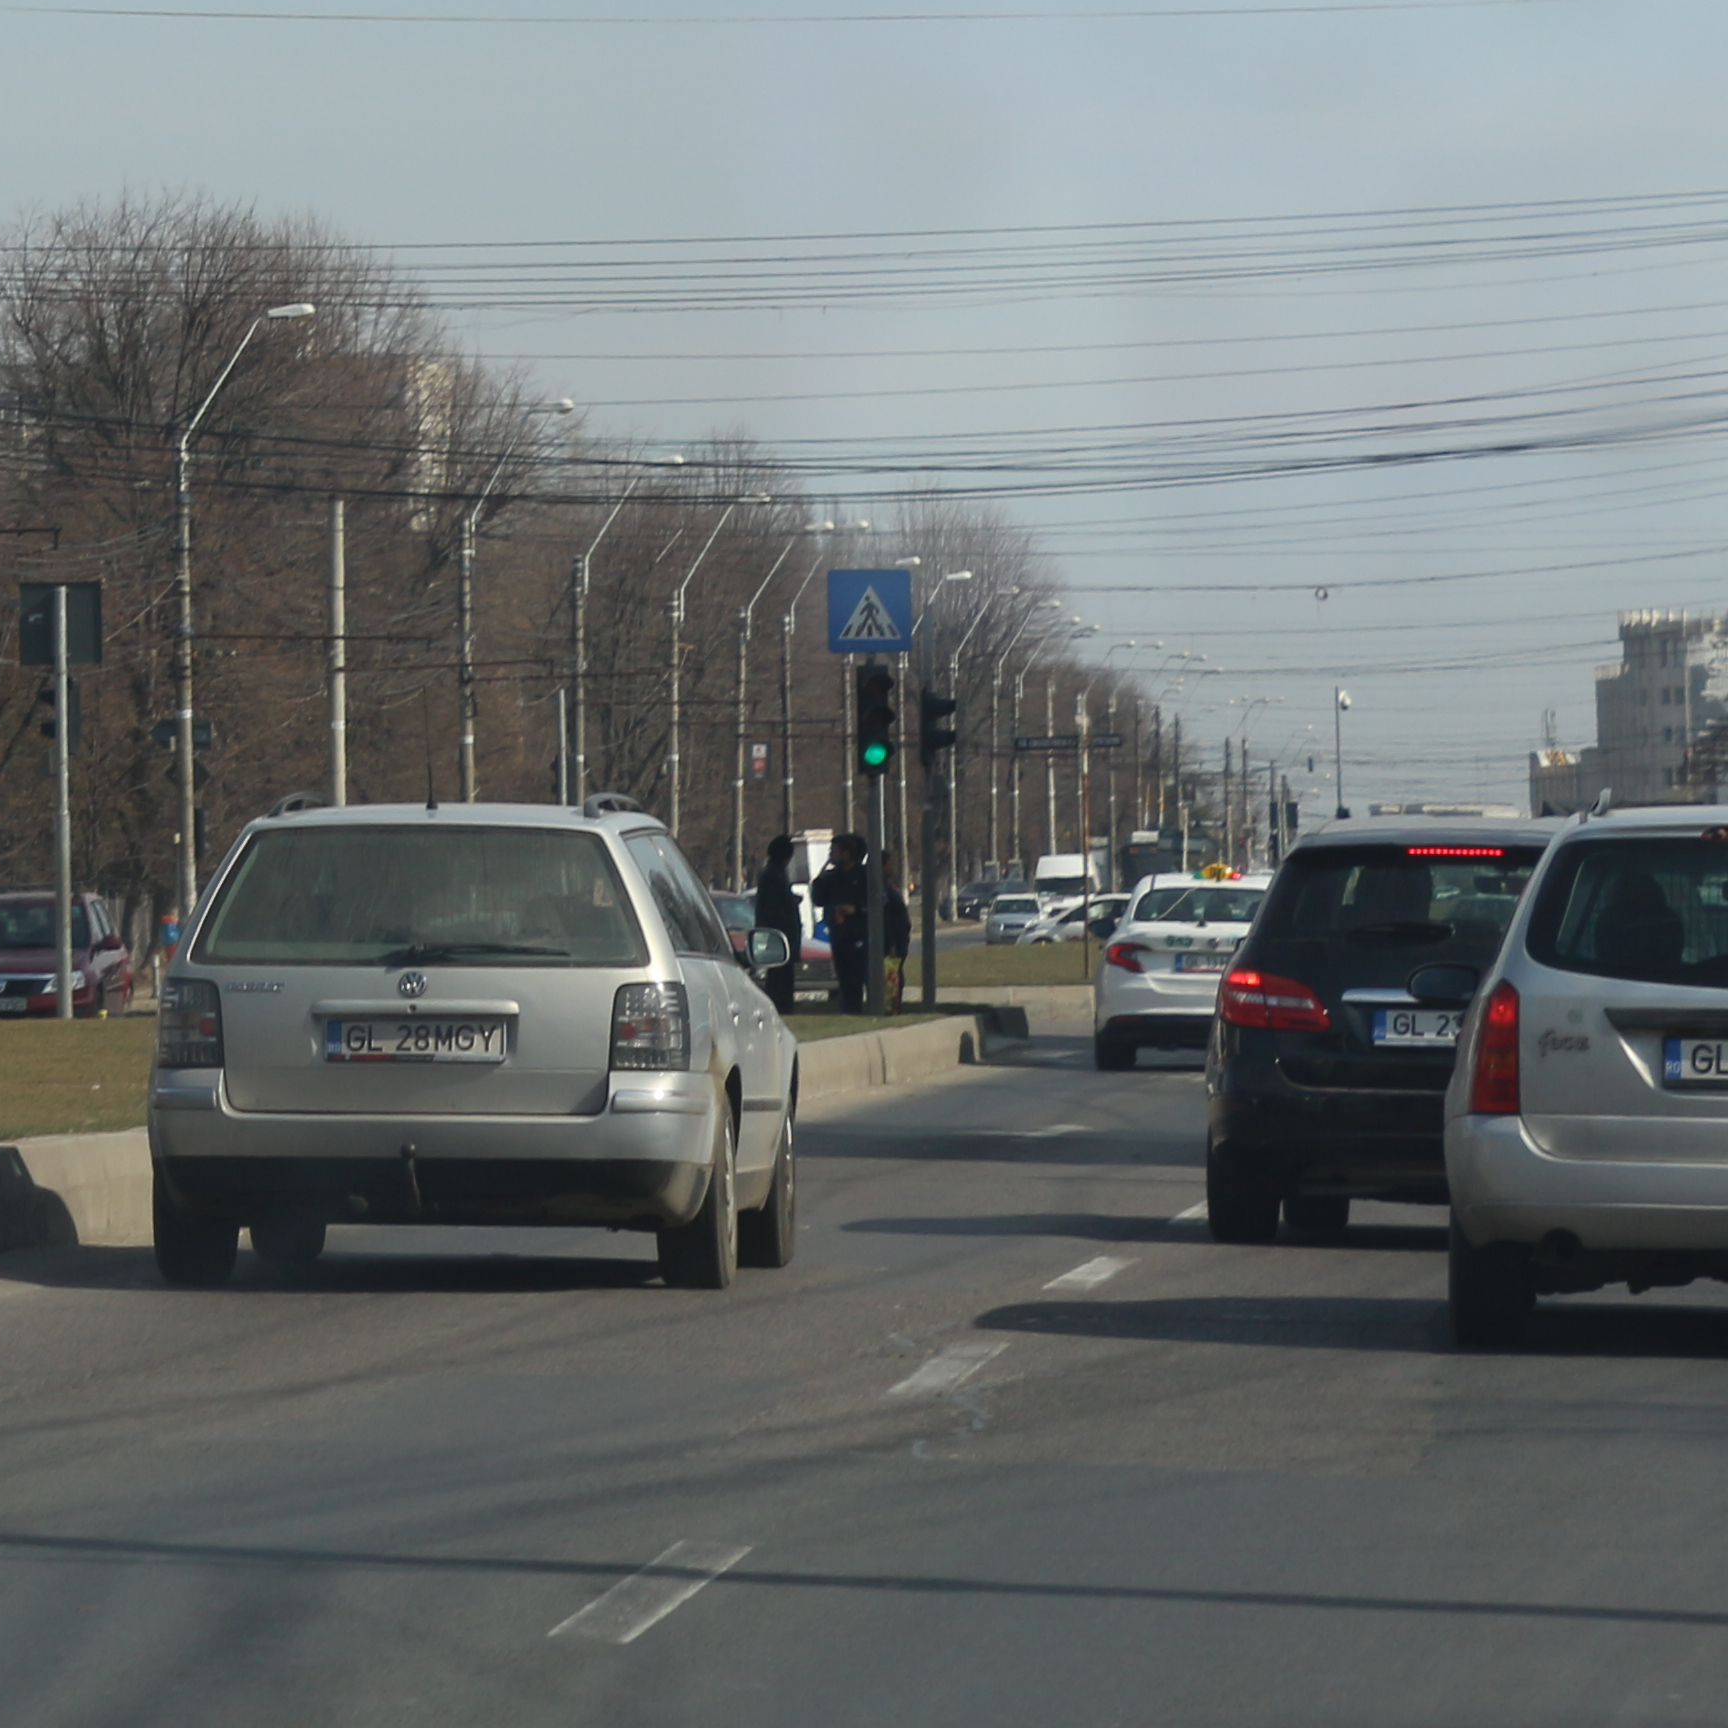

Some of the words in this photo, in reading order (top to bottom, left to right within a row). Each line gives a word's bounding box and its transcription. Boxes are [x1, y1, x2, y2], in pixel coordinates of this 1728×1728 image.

[345, 1024, 383, 1053] GL
[1392, 1013, 1425, 1038] GL
[1691, 1043, 1728, 1075] GL
